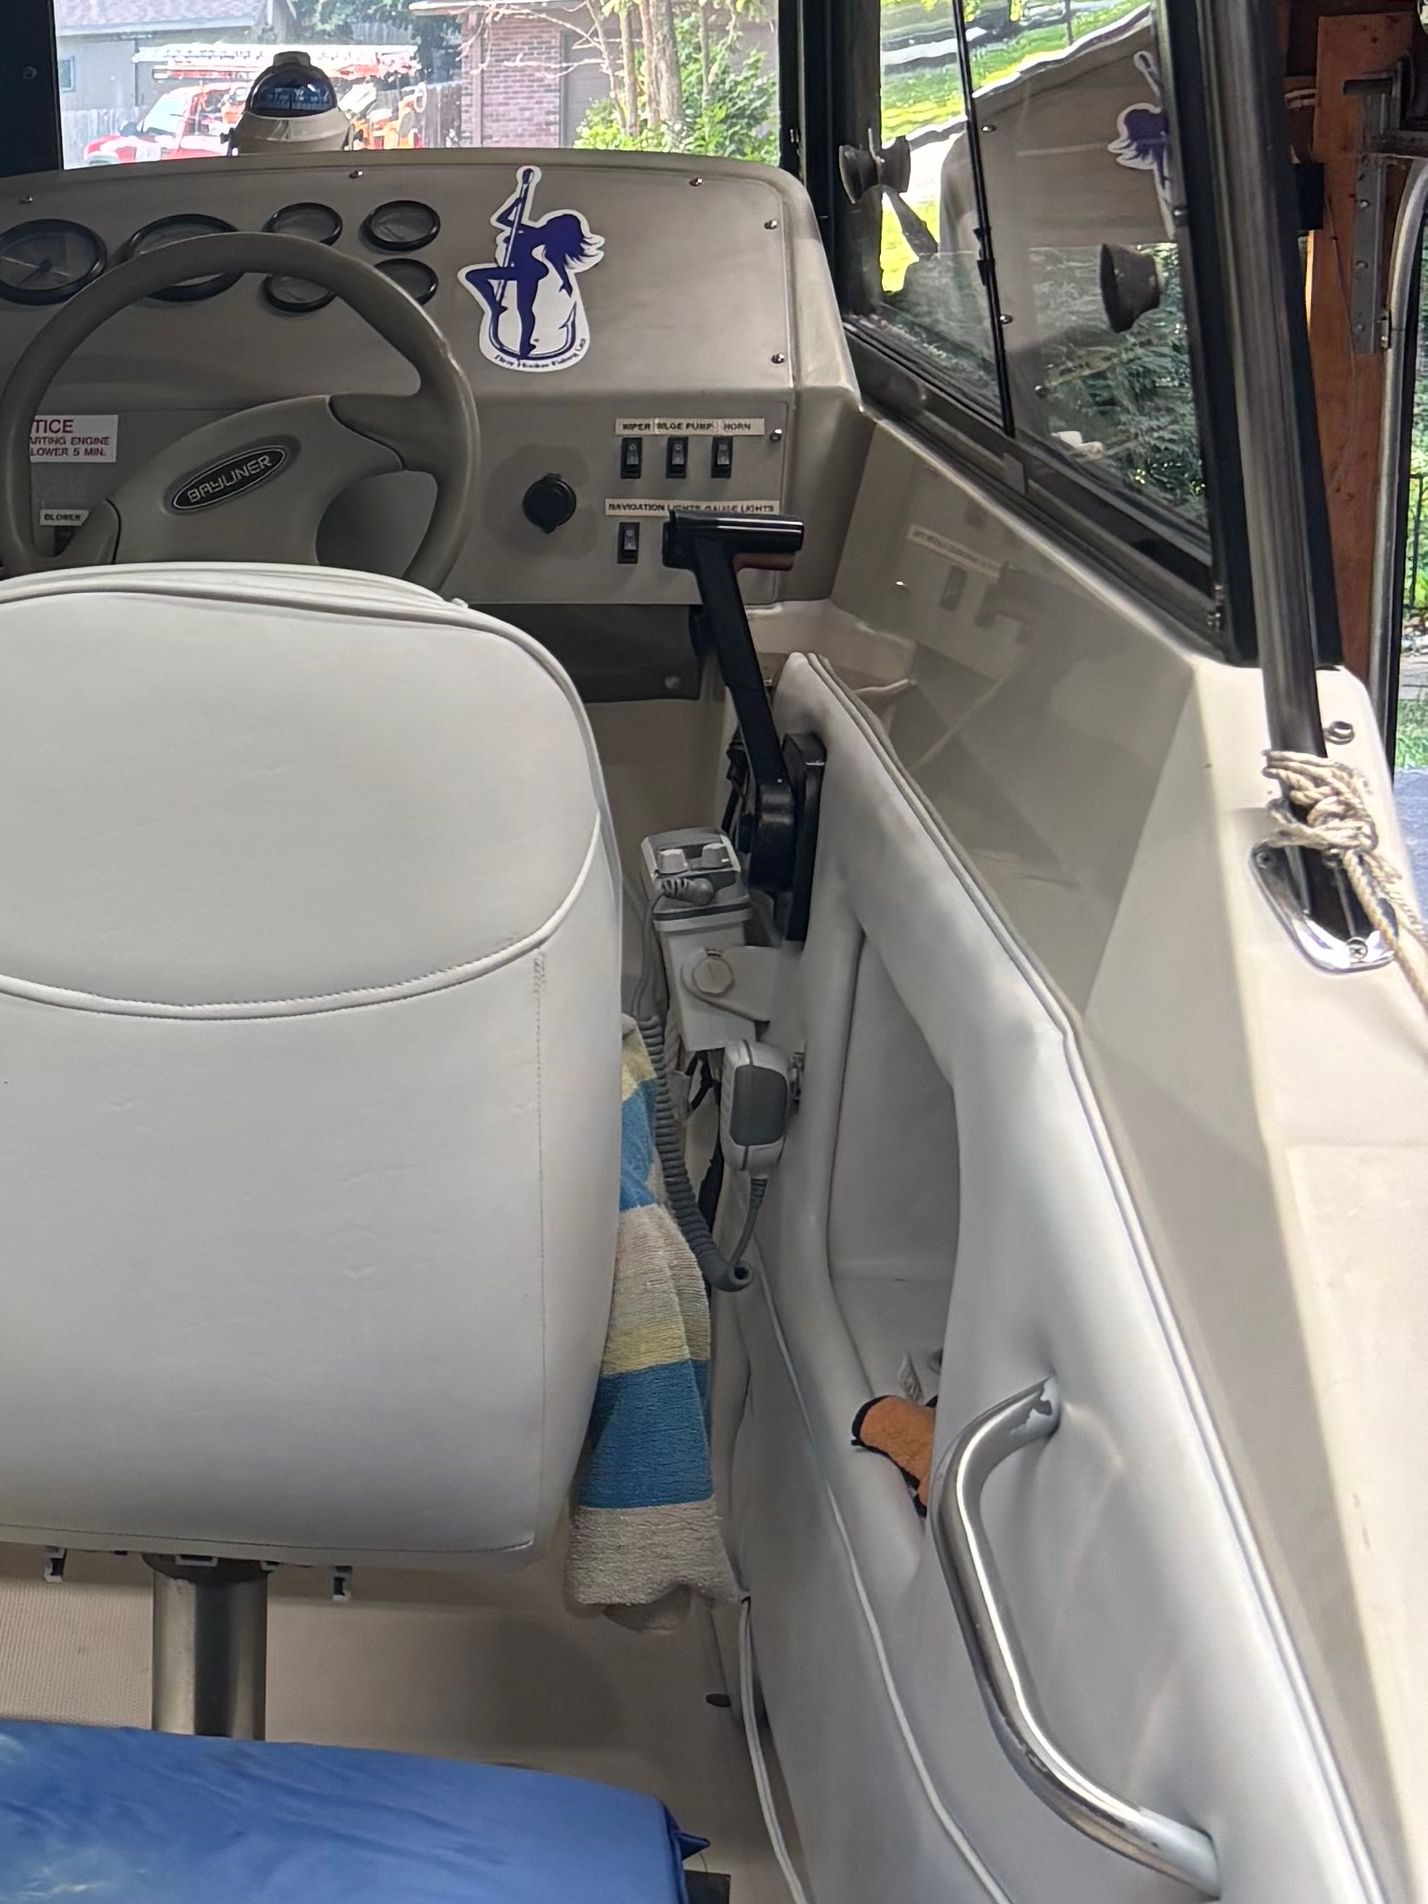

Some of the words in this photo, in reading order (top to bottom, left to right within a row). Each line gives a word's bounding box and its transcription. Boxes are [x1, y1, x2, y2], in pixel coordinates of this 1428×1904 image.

[33, 418, 75, 434] TICE
[722, 422, 752, 431] HORN
[70, 436, 111, 446] ENGINE
[30, 447, 69, 457] LOWER
[73, 447, 80, 457] 5
[83, 447, 107, 457] MIN.
[186, 454, 273, 503] BAYLINER
